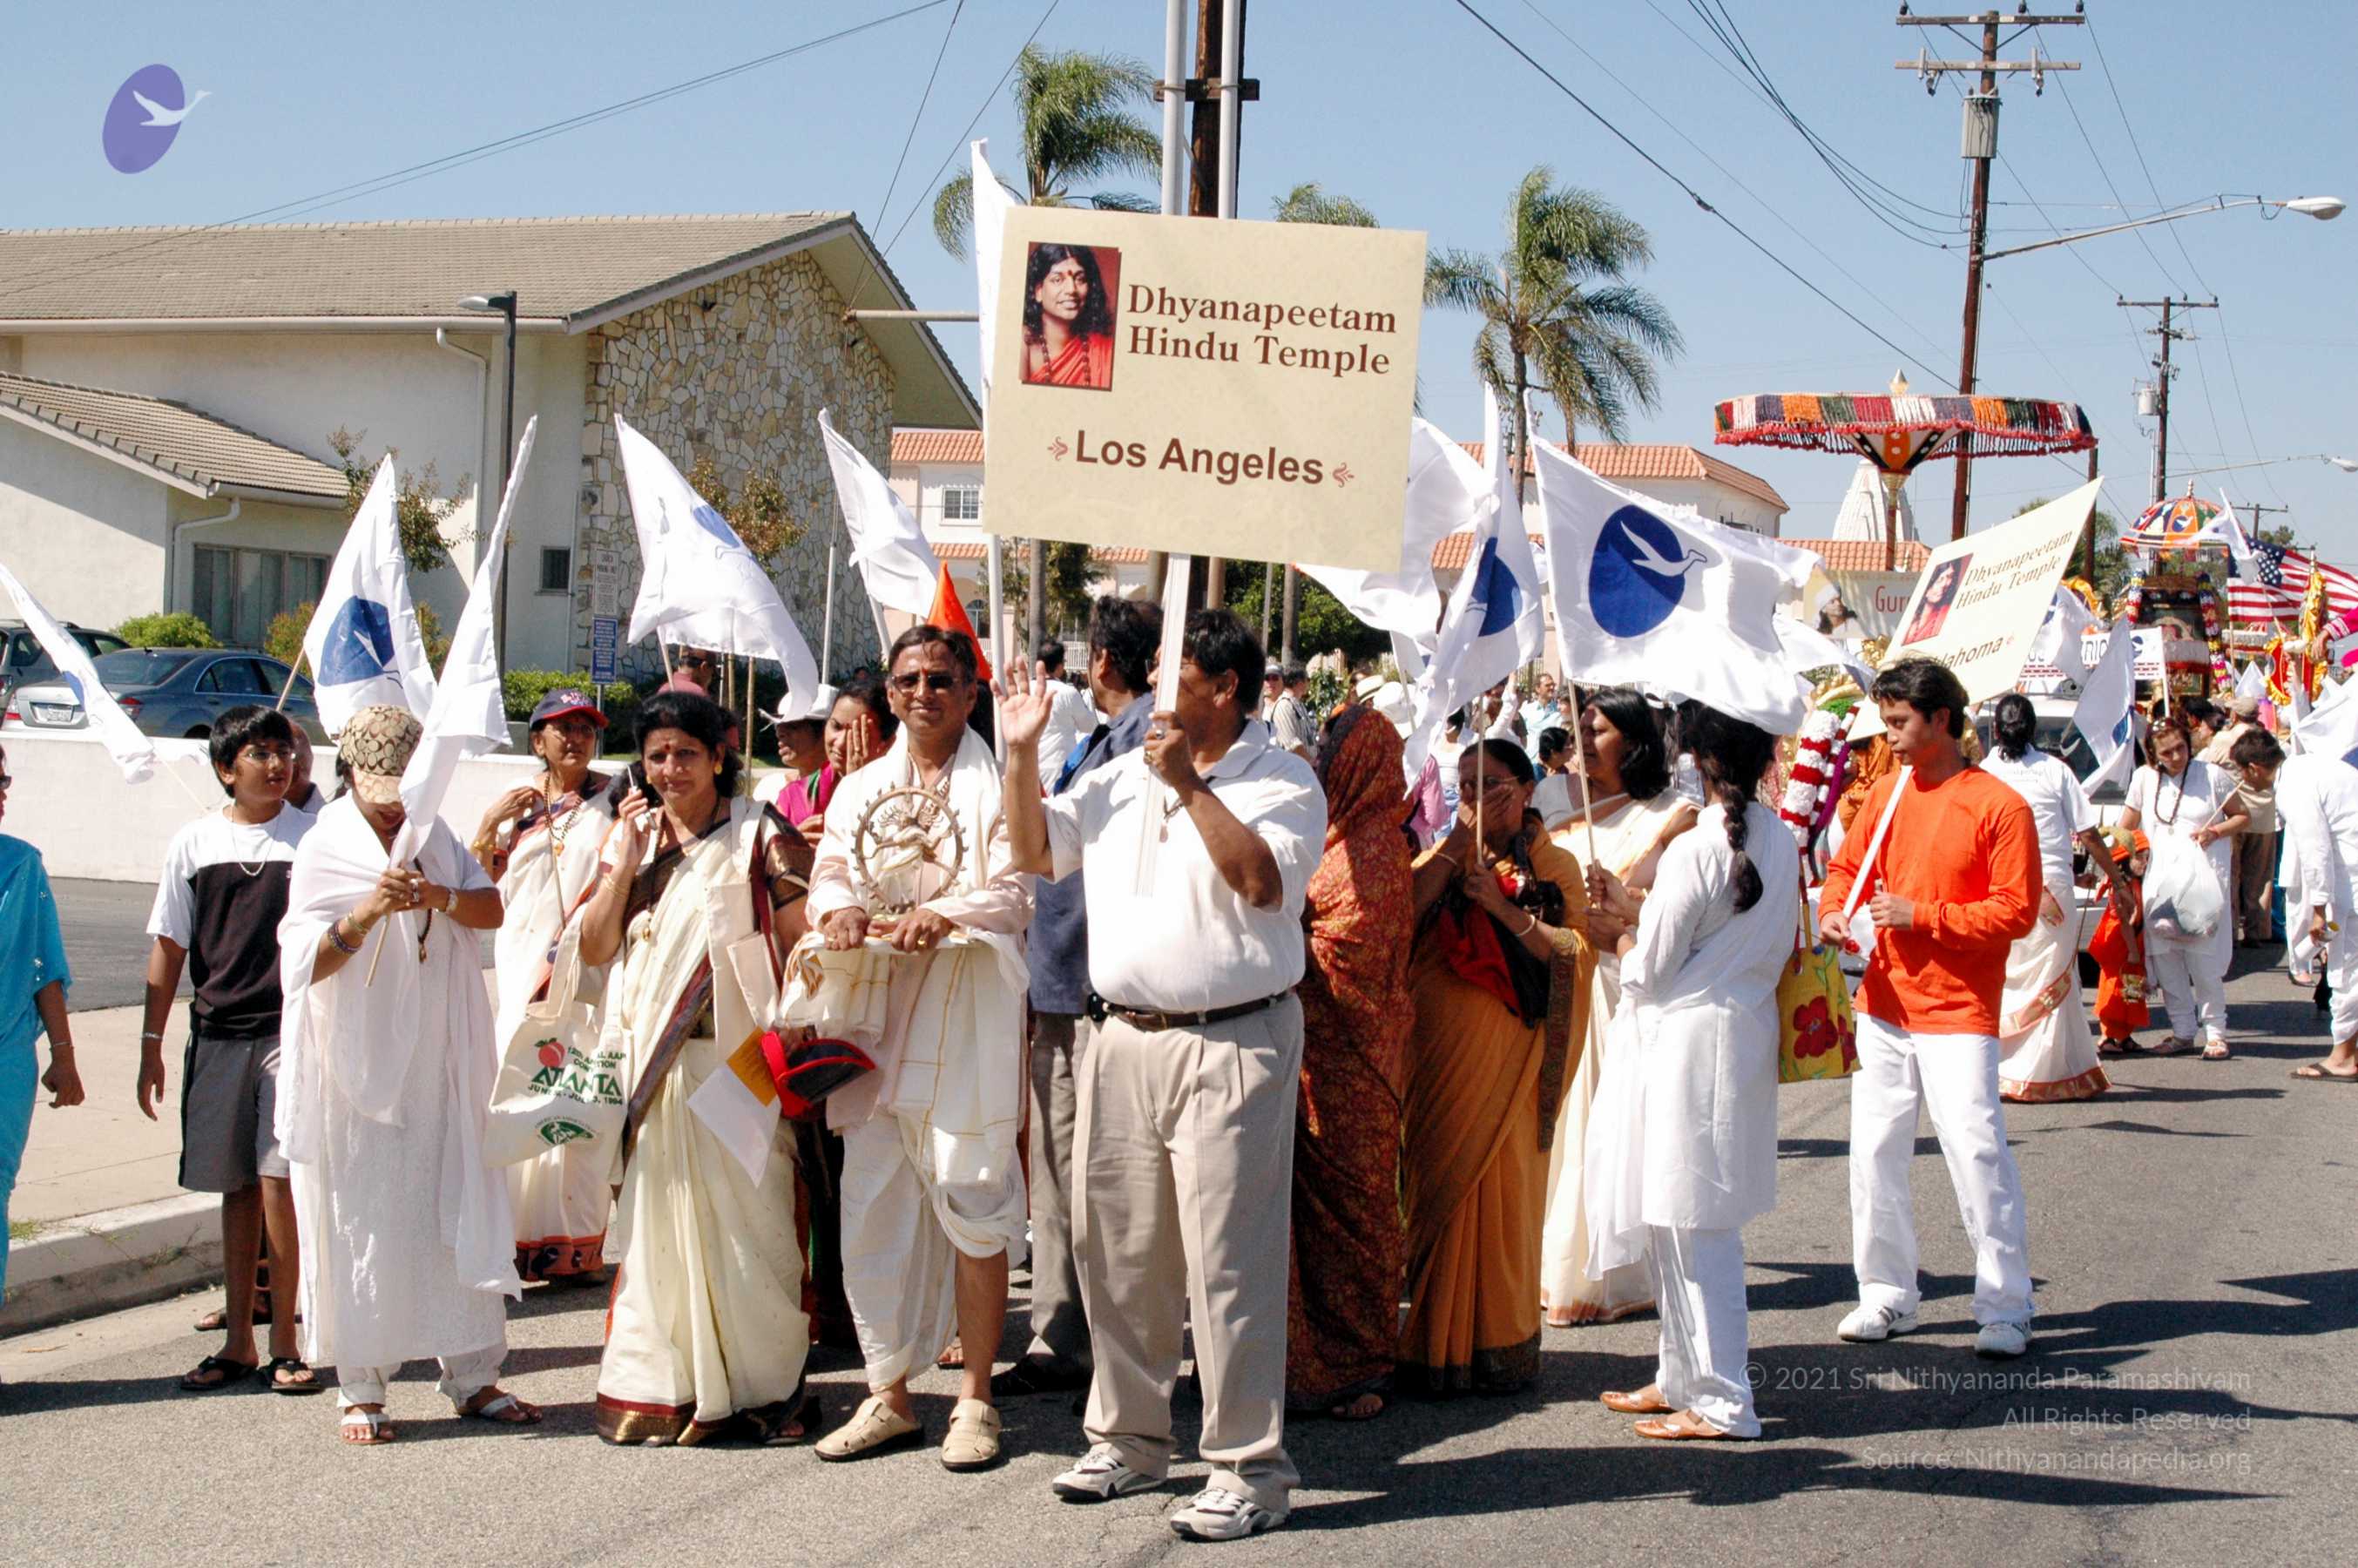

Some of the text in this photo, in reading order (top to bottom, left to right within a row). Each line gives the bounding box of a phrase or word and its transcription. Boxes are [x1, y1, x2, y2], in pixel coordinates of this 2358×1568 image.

[1126, 283, 1397, 334] Dhyanapeetam
[1127, 324, 1390, 378] Hindu Temple
[1076, 429, 1324, 485] Los Angeles
[1956, 556, 2061, 610] Hindu Temple
[1965, 531, 2072, 586] Dhyanapeetam
